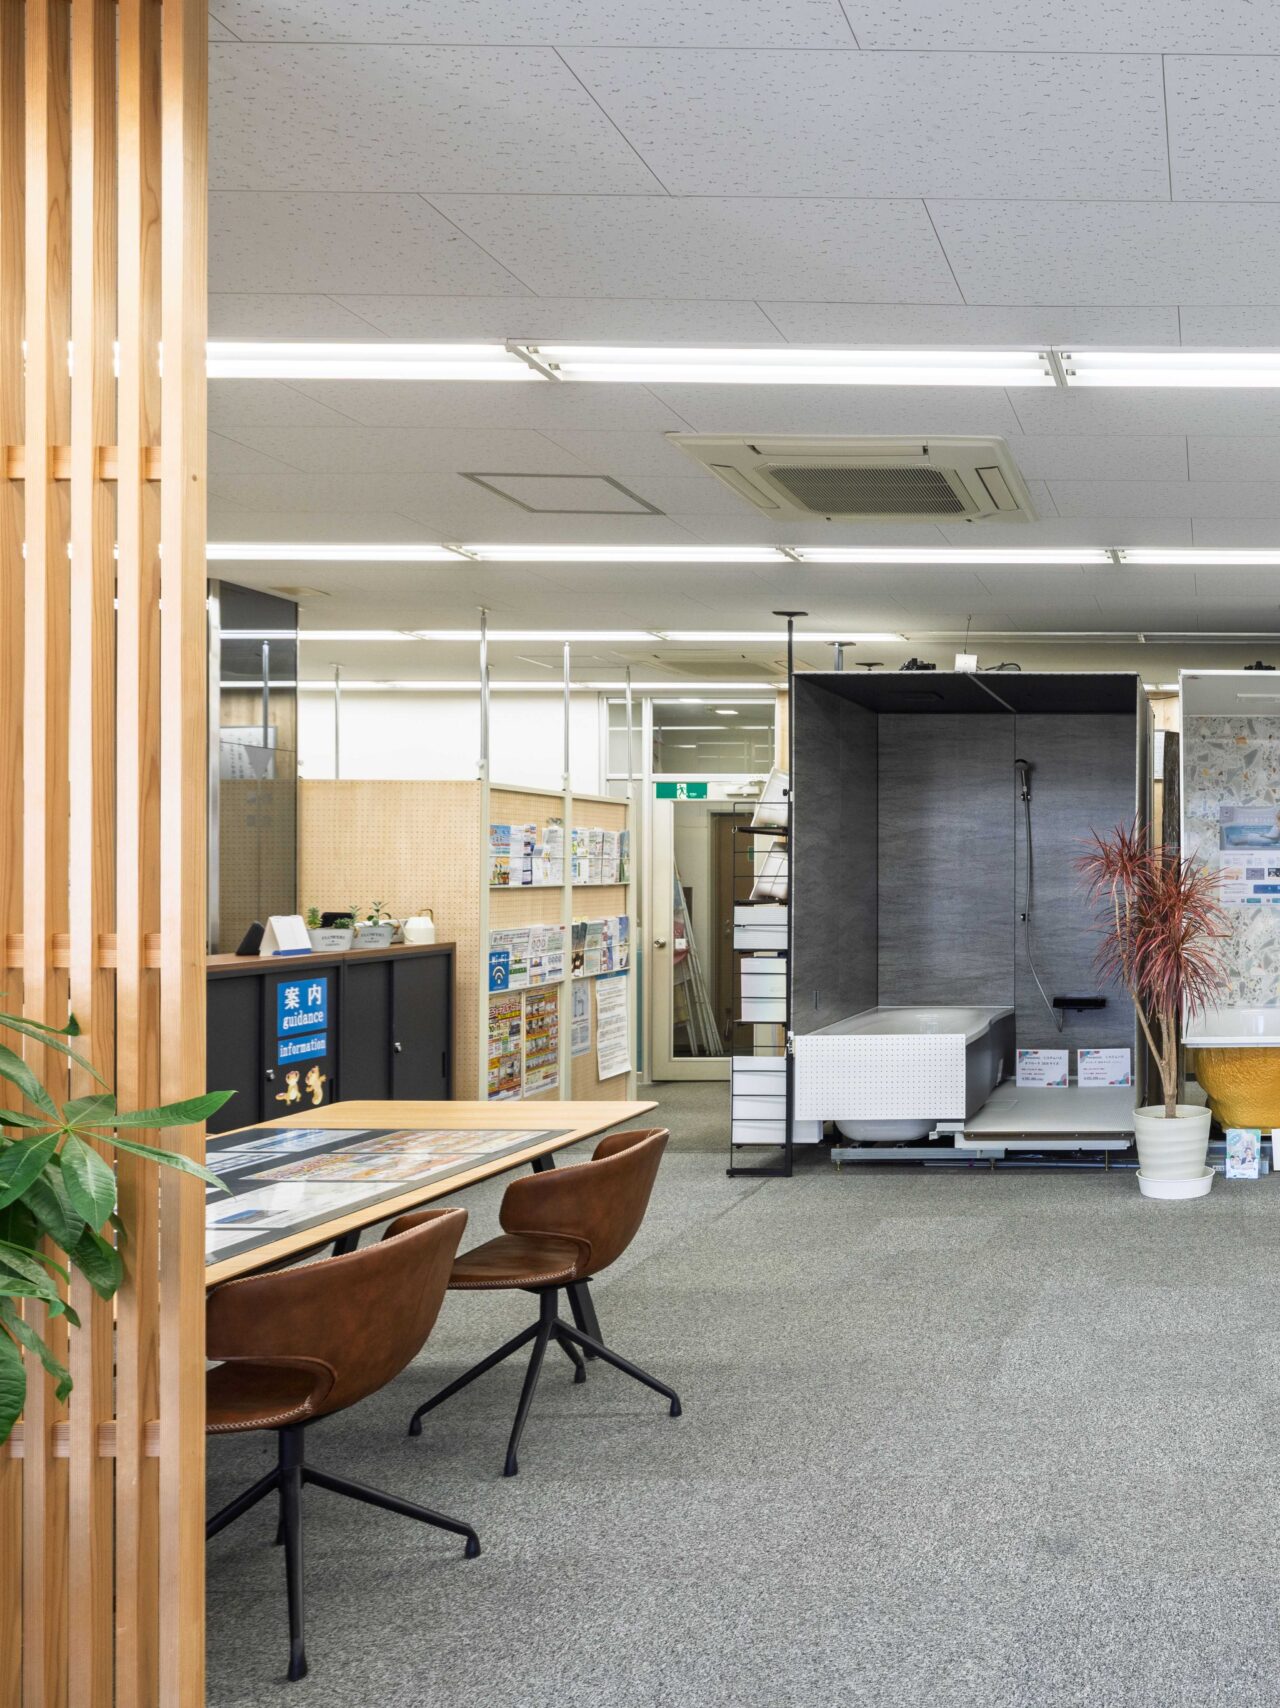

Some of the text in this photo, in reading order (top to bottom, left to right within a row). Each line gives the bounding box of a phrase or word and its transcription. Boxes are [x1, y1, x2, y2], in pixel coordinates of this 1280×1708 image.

[284, 984, 322, 1009] 案内
[283, 1010, 323, 1029] guidance
[280, 1039, 326, 1057] information
